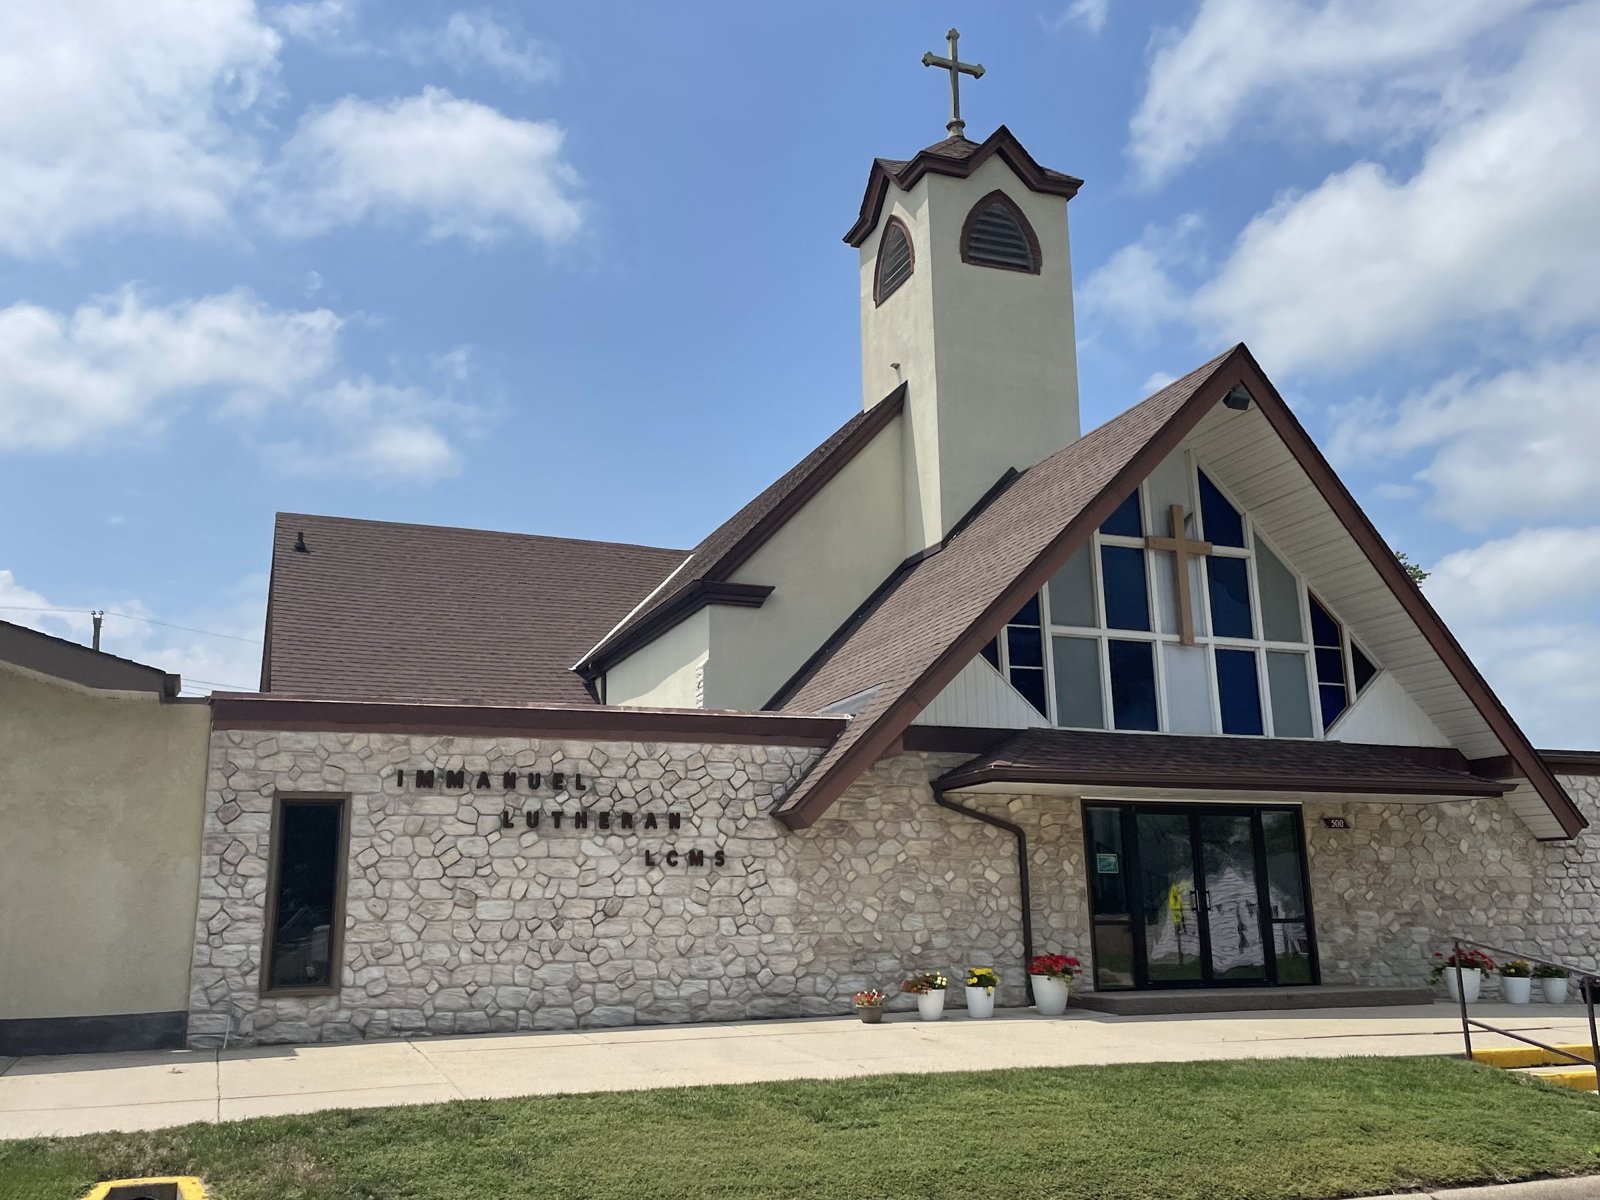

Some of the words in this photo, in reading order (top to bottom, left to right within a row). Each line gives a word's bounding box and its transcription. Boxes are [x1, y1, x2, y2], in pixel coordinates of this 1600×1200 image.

[397, 769, 587, 791] IMMANUEL
[503, 811, 681, 830] LUTHERAN
[1330, 819, 1344, 828] 500
[645, 849, 725, 867] LCMS
